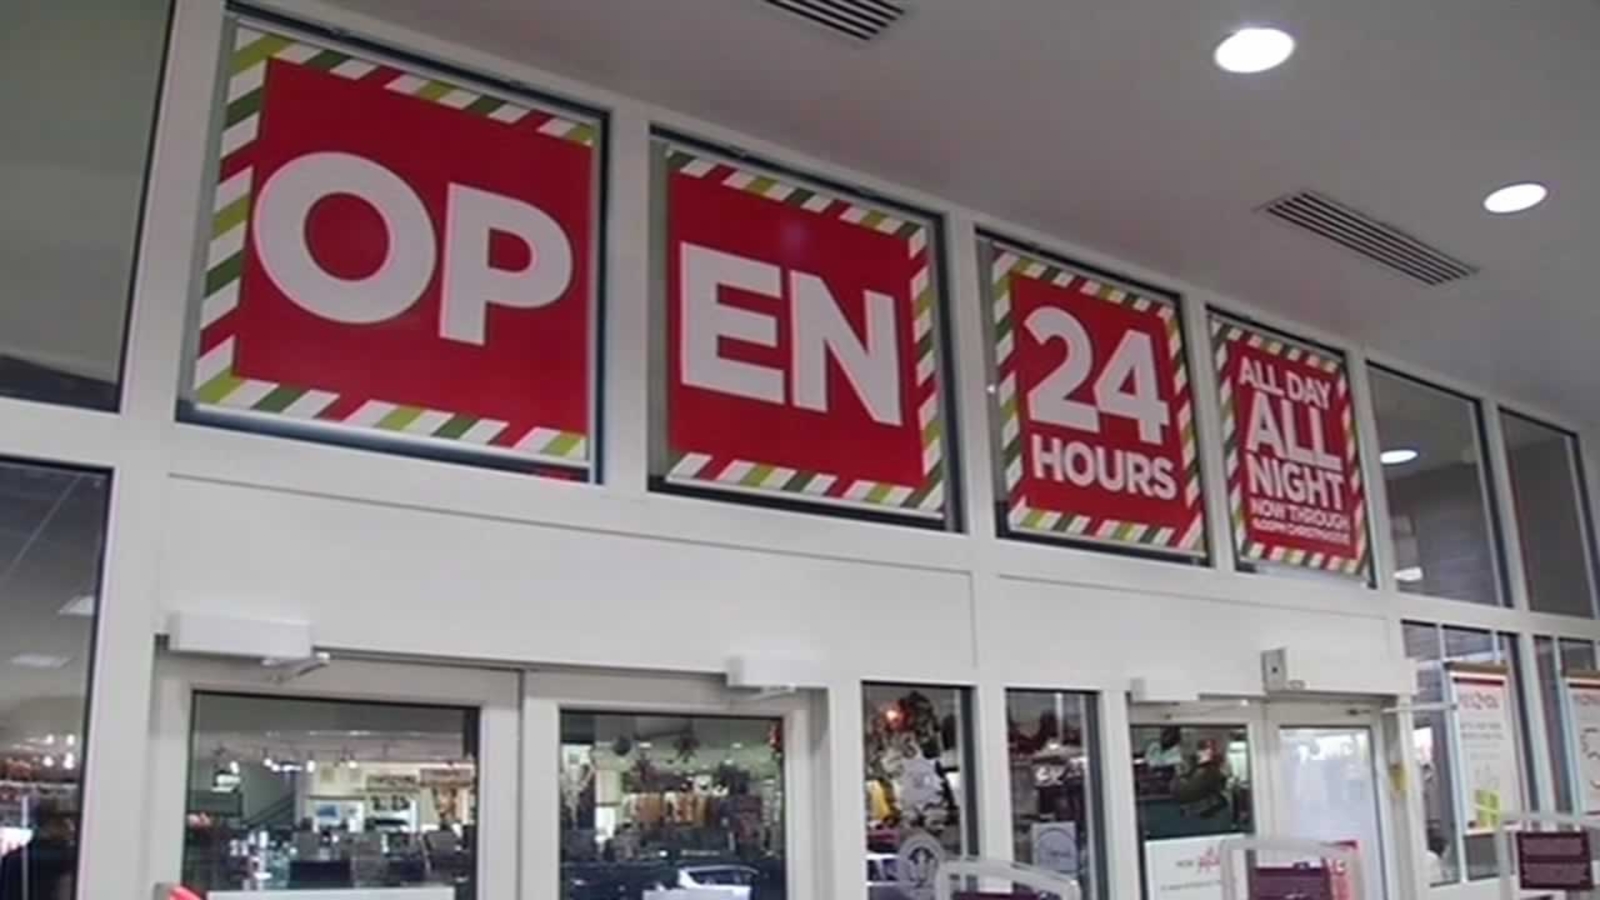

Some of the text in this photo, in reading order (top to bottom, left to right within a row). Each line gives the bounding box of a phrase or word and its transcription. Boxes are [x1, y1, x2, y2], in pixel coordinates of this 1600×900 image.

[1023, 306, 1169, 445] 24
[1238, 356, 1331, 410] ALL DAY
[1246, 391, 1344, 472] ALL
[1031, 434, 1178, 500] HOURS
[1246, 453, 1345, 511] NIGHT
